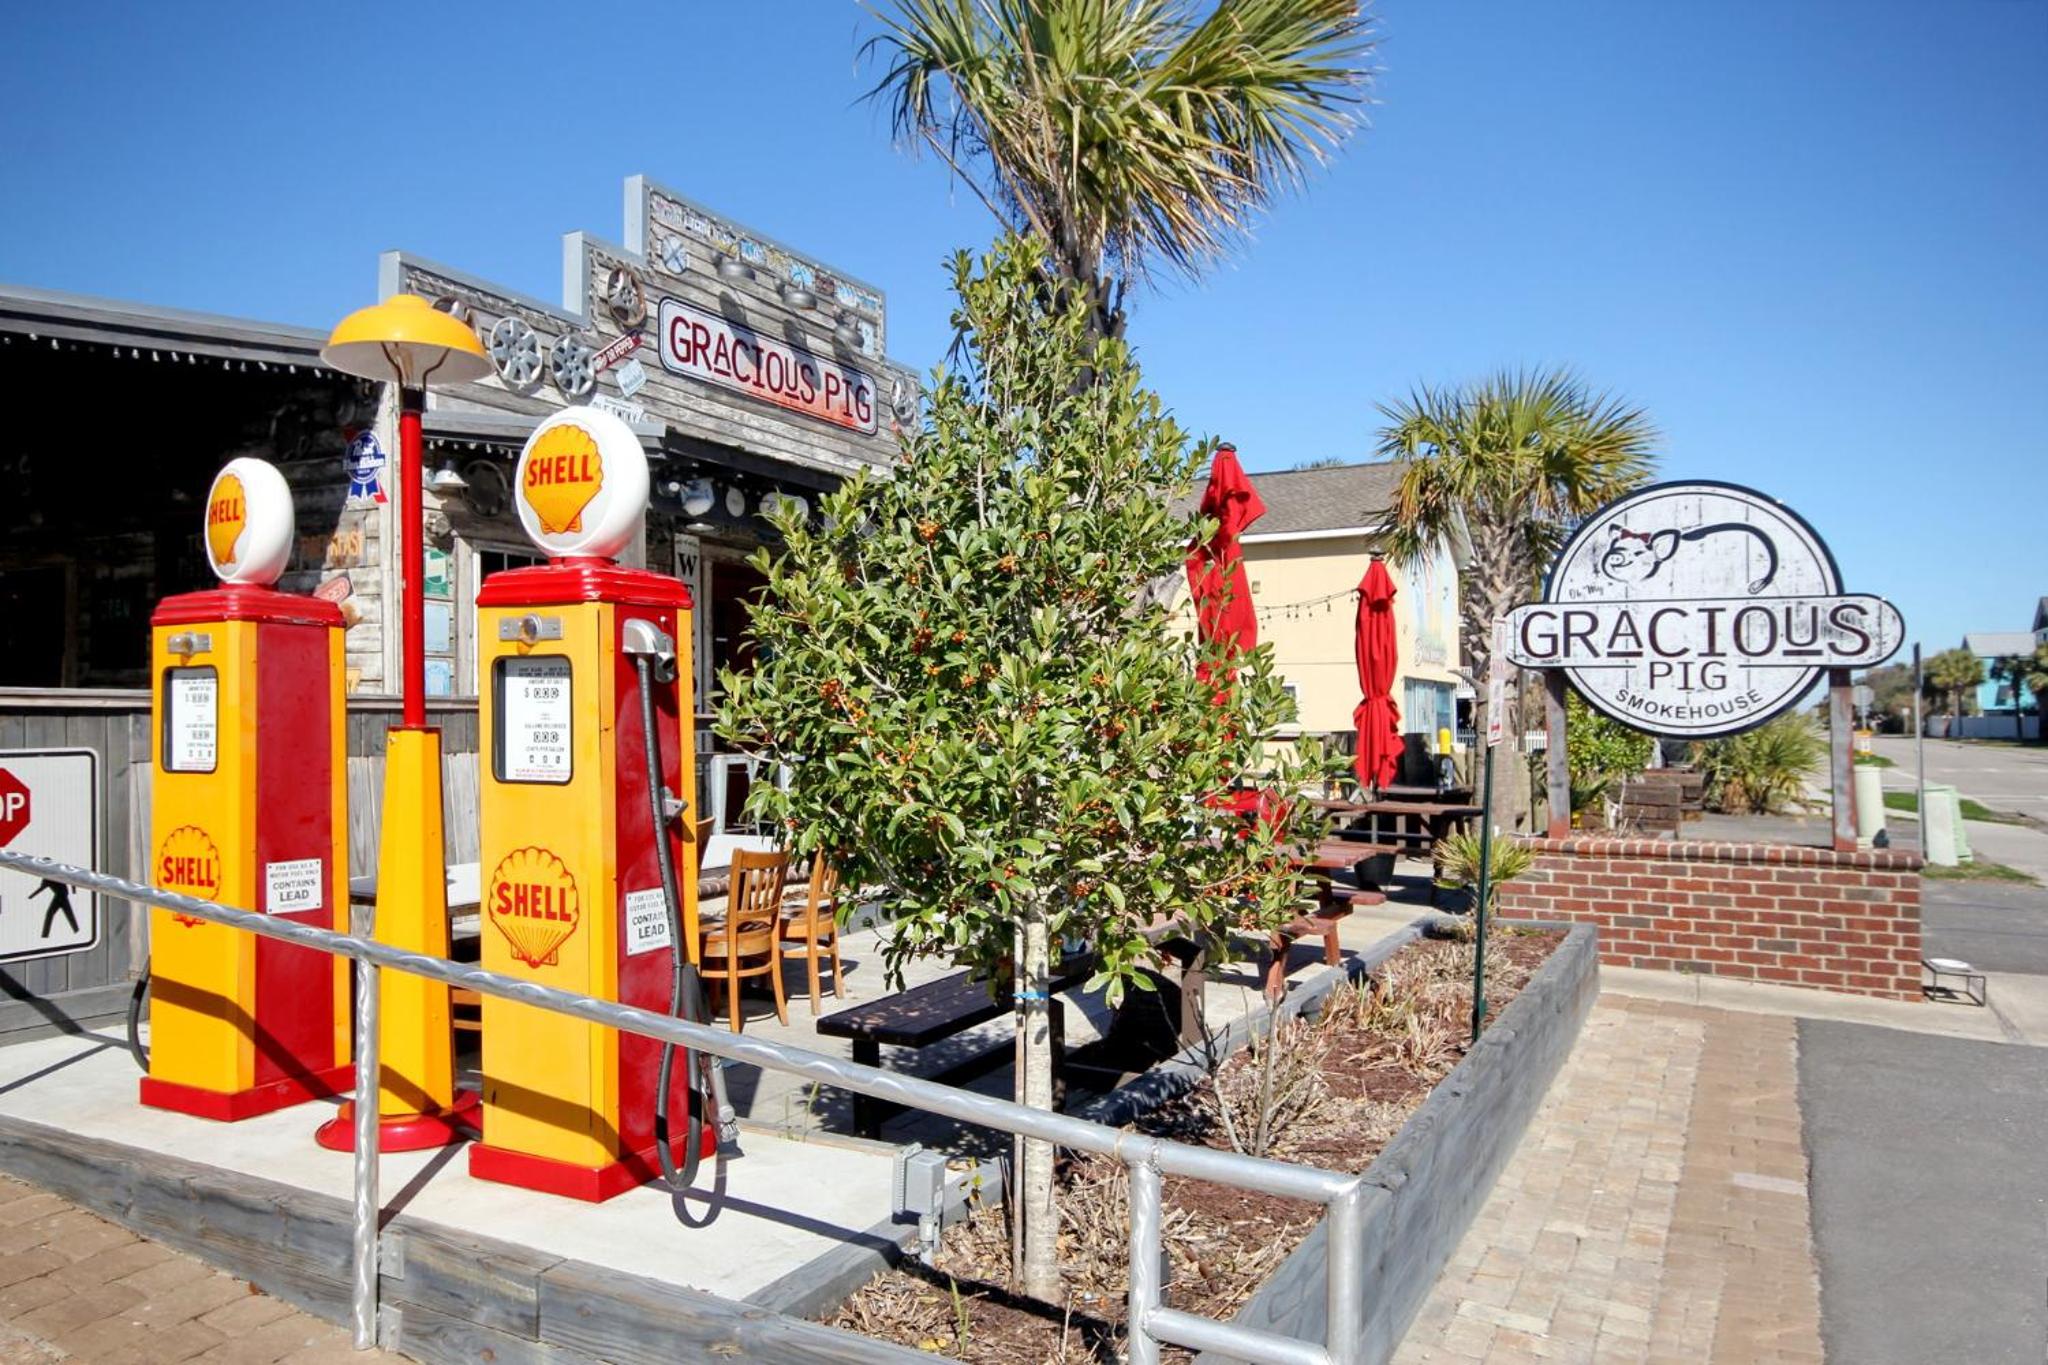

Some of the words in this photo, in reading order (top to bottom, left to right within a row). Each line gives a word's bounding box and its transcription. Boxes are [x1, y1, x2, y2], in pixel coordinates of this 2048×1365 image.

[670, 316, 815, 404] GRACIOUS
[825, 371, 870, 423] PIG
[528, 454, 594, 487] SHELL
[1520, 604, 1871, 659] GRACIOUS
[1649, 661, 1728, 691] PIG
[1615, 689, 1764, 719] SMOKEHOUSE
[163, 856, 215, 888] SHELL
[273, 878, 316, 890] CONTAINS
[280, 889, 309, 902] LEAD
[497, 882, 571, 922] SHELL
[631, 911, 665, 926] CONTAIN
[639, 923, 665, 939] LEAD
